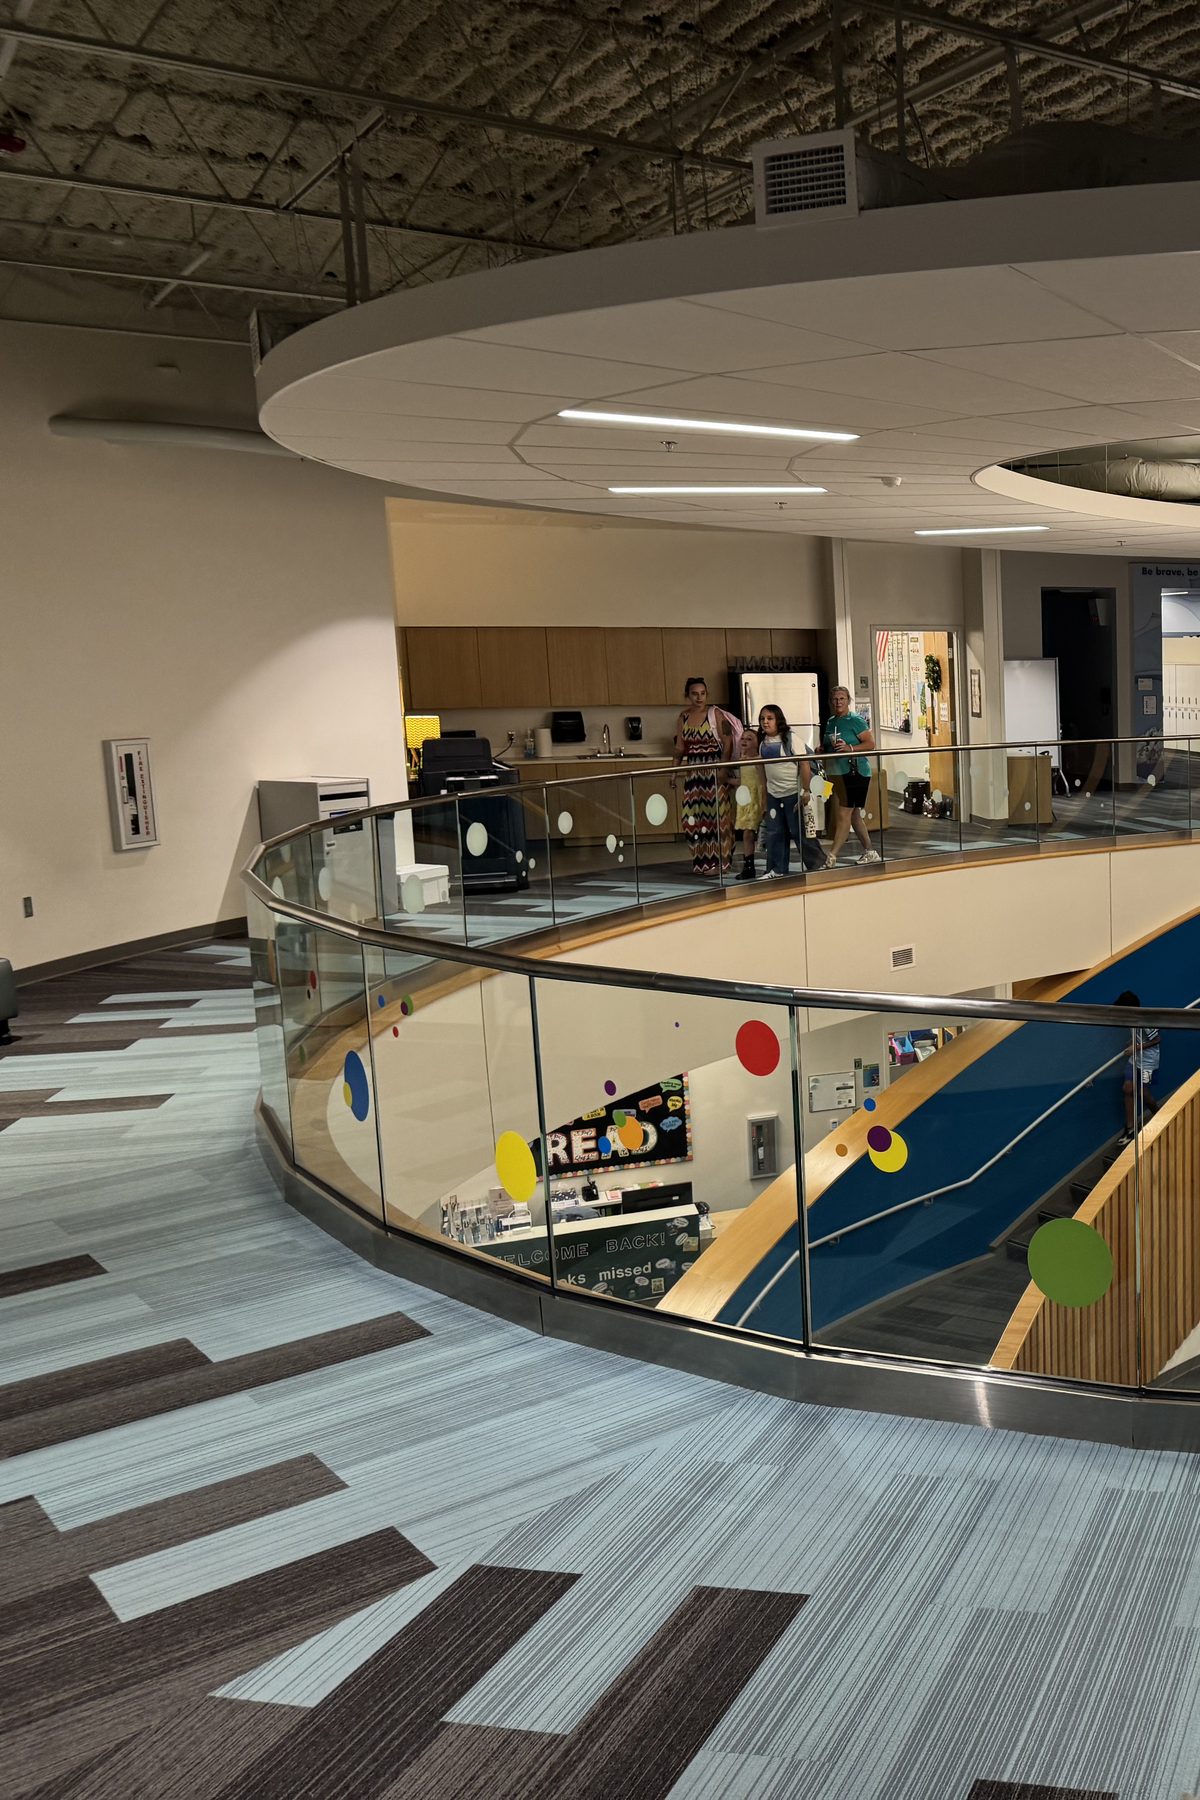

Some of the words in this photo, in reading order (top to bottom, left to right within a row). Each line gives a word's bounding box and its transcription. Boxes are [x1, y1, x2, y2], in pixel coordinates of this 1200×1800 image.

[1141, 566, 1154, 576] Be
[1187, 567, 1199, 577] be
[606, 1232, 666, 1253] BACK!
[598, 1261, 652, 1282] missed
